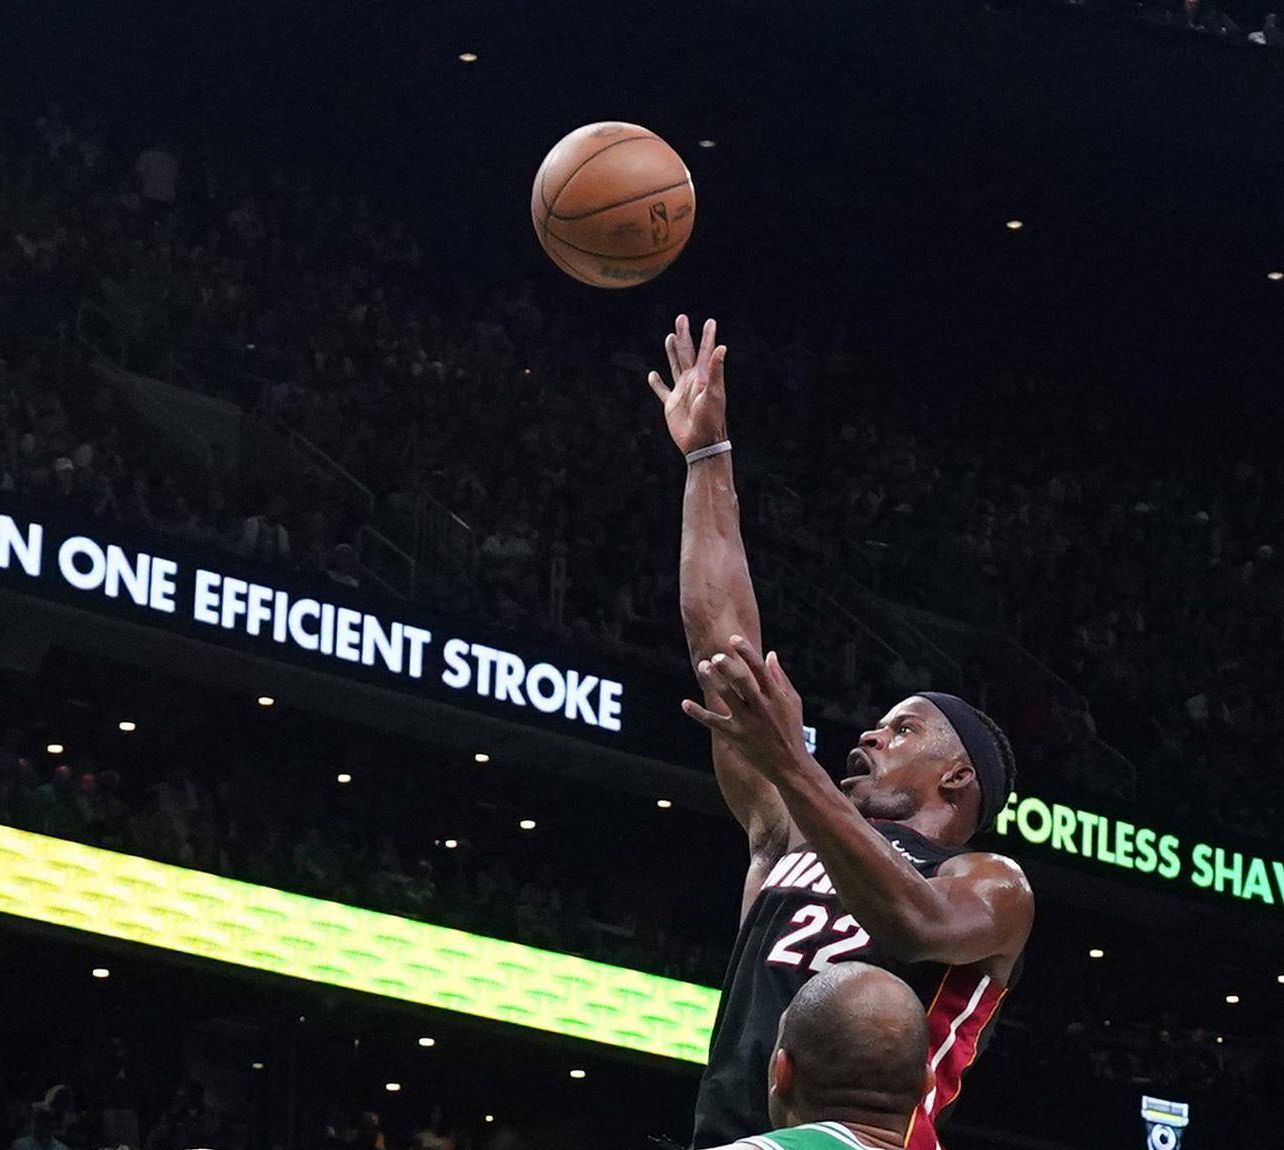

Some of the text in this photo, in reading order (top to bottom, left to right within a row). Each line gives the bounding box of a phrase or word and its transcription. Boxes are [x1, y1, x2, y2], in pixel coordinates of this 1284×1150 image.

[59, 536, 177, 613] ONE
[194, 569, 430, 678] EFFICIENT
[442, 638, 623, 731] STROKE
[767, 903, 870, 973] 22
